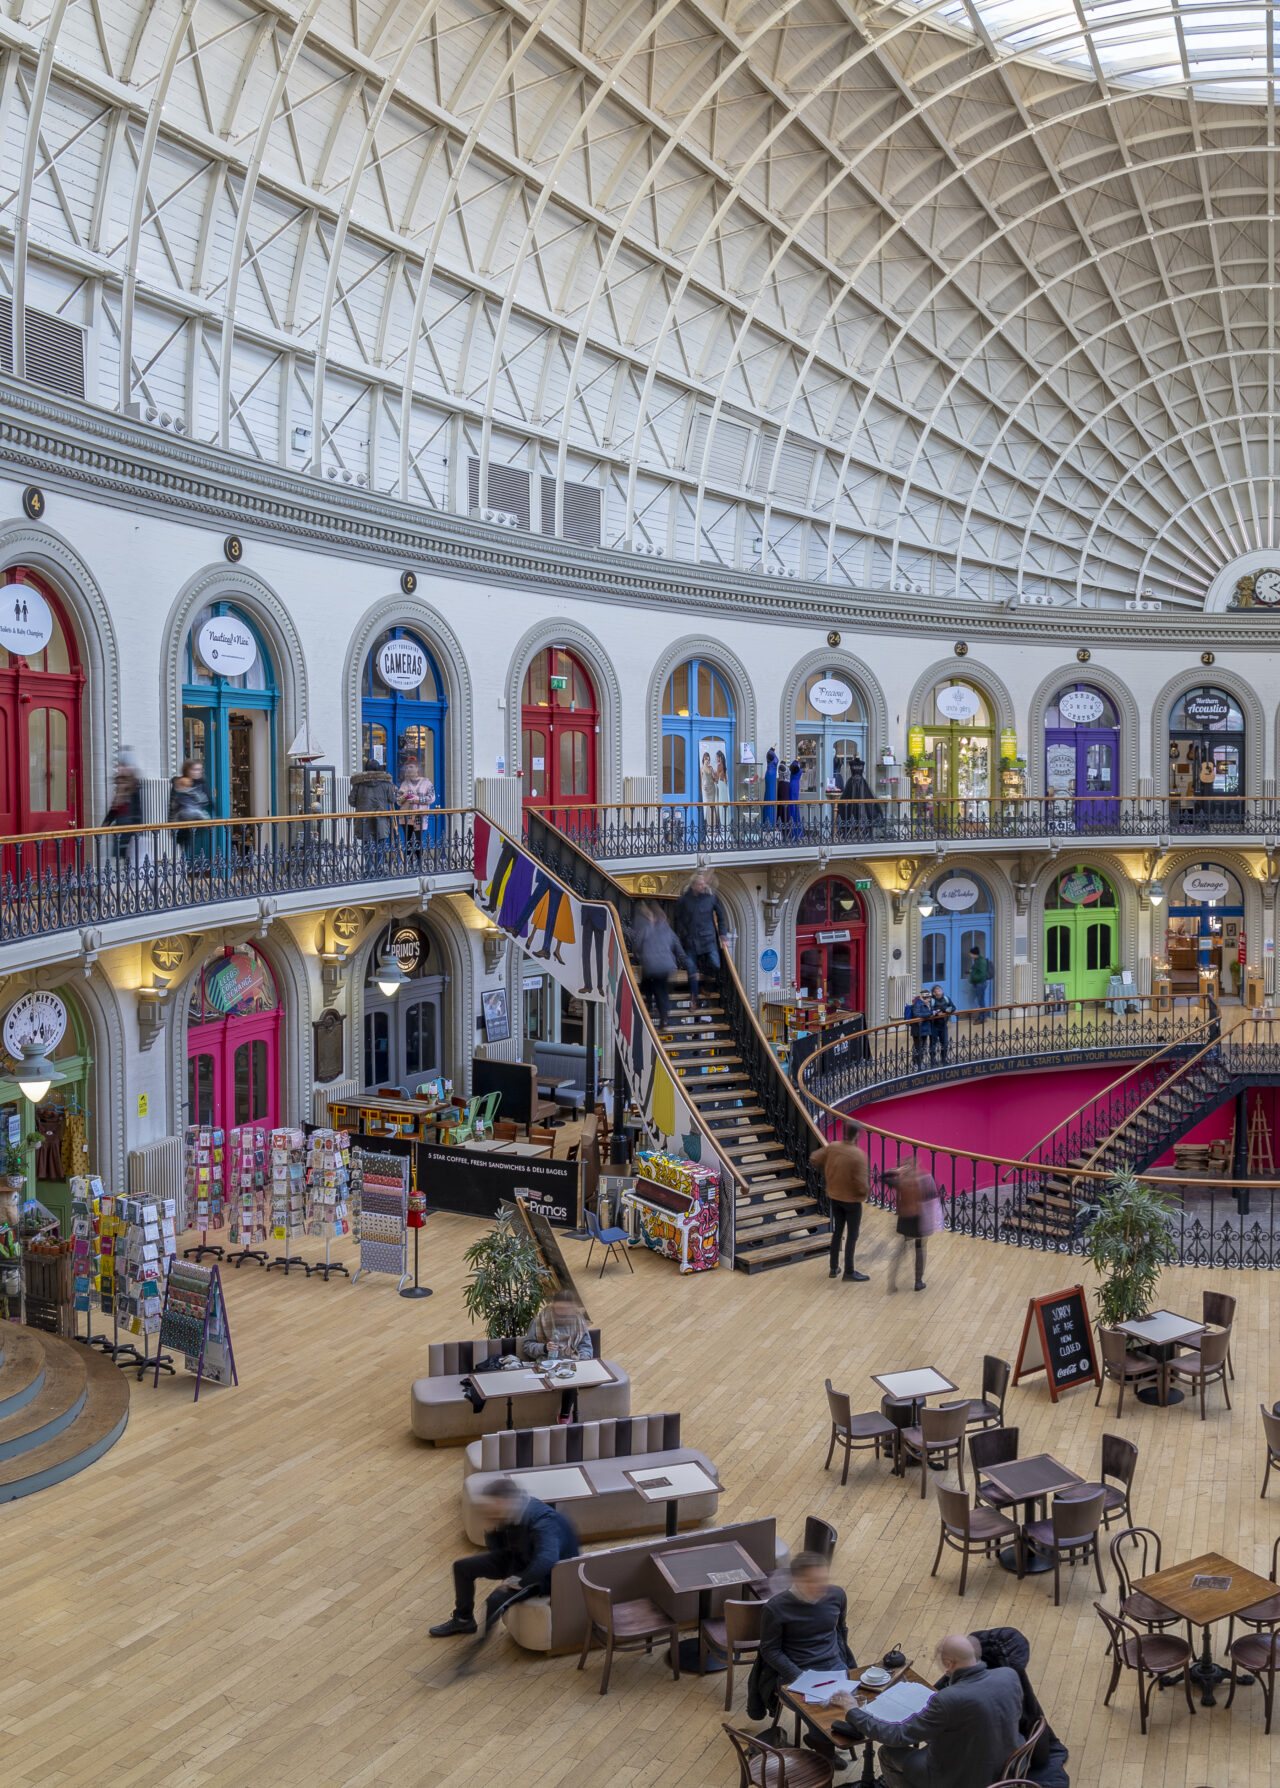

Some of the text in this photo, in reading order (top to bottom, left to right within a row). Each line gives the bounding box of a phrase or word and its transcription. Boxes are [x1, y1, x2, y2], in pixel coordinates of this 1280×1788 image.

[32, 494, 41, 511] 4
[231, 541, 239, 556] 3
[407, 576, 414, 588] 2
[830, 633, 840, 643] 24
[956, 644, 966, 652] 23
[1079, 651, 1089, 659] 22
[384, 653, 422, 676] CAMERAS
[1203, 655, 1213, 663] 21
[1188, 703, 1227, 714] Acoustics
[1191, 879, 1224, 890] Outrage
[391, 941, 419, 958] PRIMO'S
[219, 968, 238, 986] LEEDS
[223, 974, 253, 1002] EXCHANGE
[8, 994, 63, 1030] GIANT KITTEN
[888, 1085, 895, 1094] TO
[926, 1074, 940, 1083] CAN
[945, 1069, 960, 1080] CAN
[961, 1067, 972, 1076] WE
[974, 1065, 987, 1074] ALL
[1008, 1061, 1015, 1069] IT
[1017, 1058, 1030, 1067] ALL
[1033, 1055, 1060, 1065] STARTS
[1063, 1053, 1082, 1062] WITH
[1085, 1051, 1104, 1060] YOUR
[433, 1153, 446, 1161] STAR
[446, 1155, 470, 1165] COFFEE,
[470, 1159, 487, 1167] FRESH
[488, 1161, 525, 1172] SANDWICHES
[532, 1166, 544, 1174] DELI
[545, 1168, 568, 1176] BAGELS
[1052, 1304, 1071, 1321] SORRY
[1052, 1320, 1074, 1335] WE ARE
[1060, 1334, 1072, 1344] NOW
[1059, 1342, 1081, 1357] CLOSED
